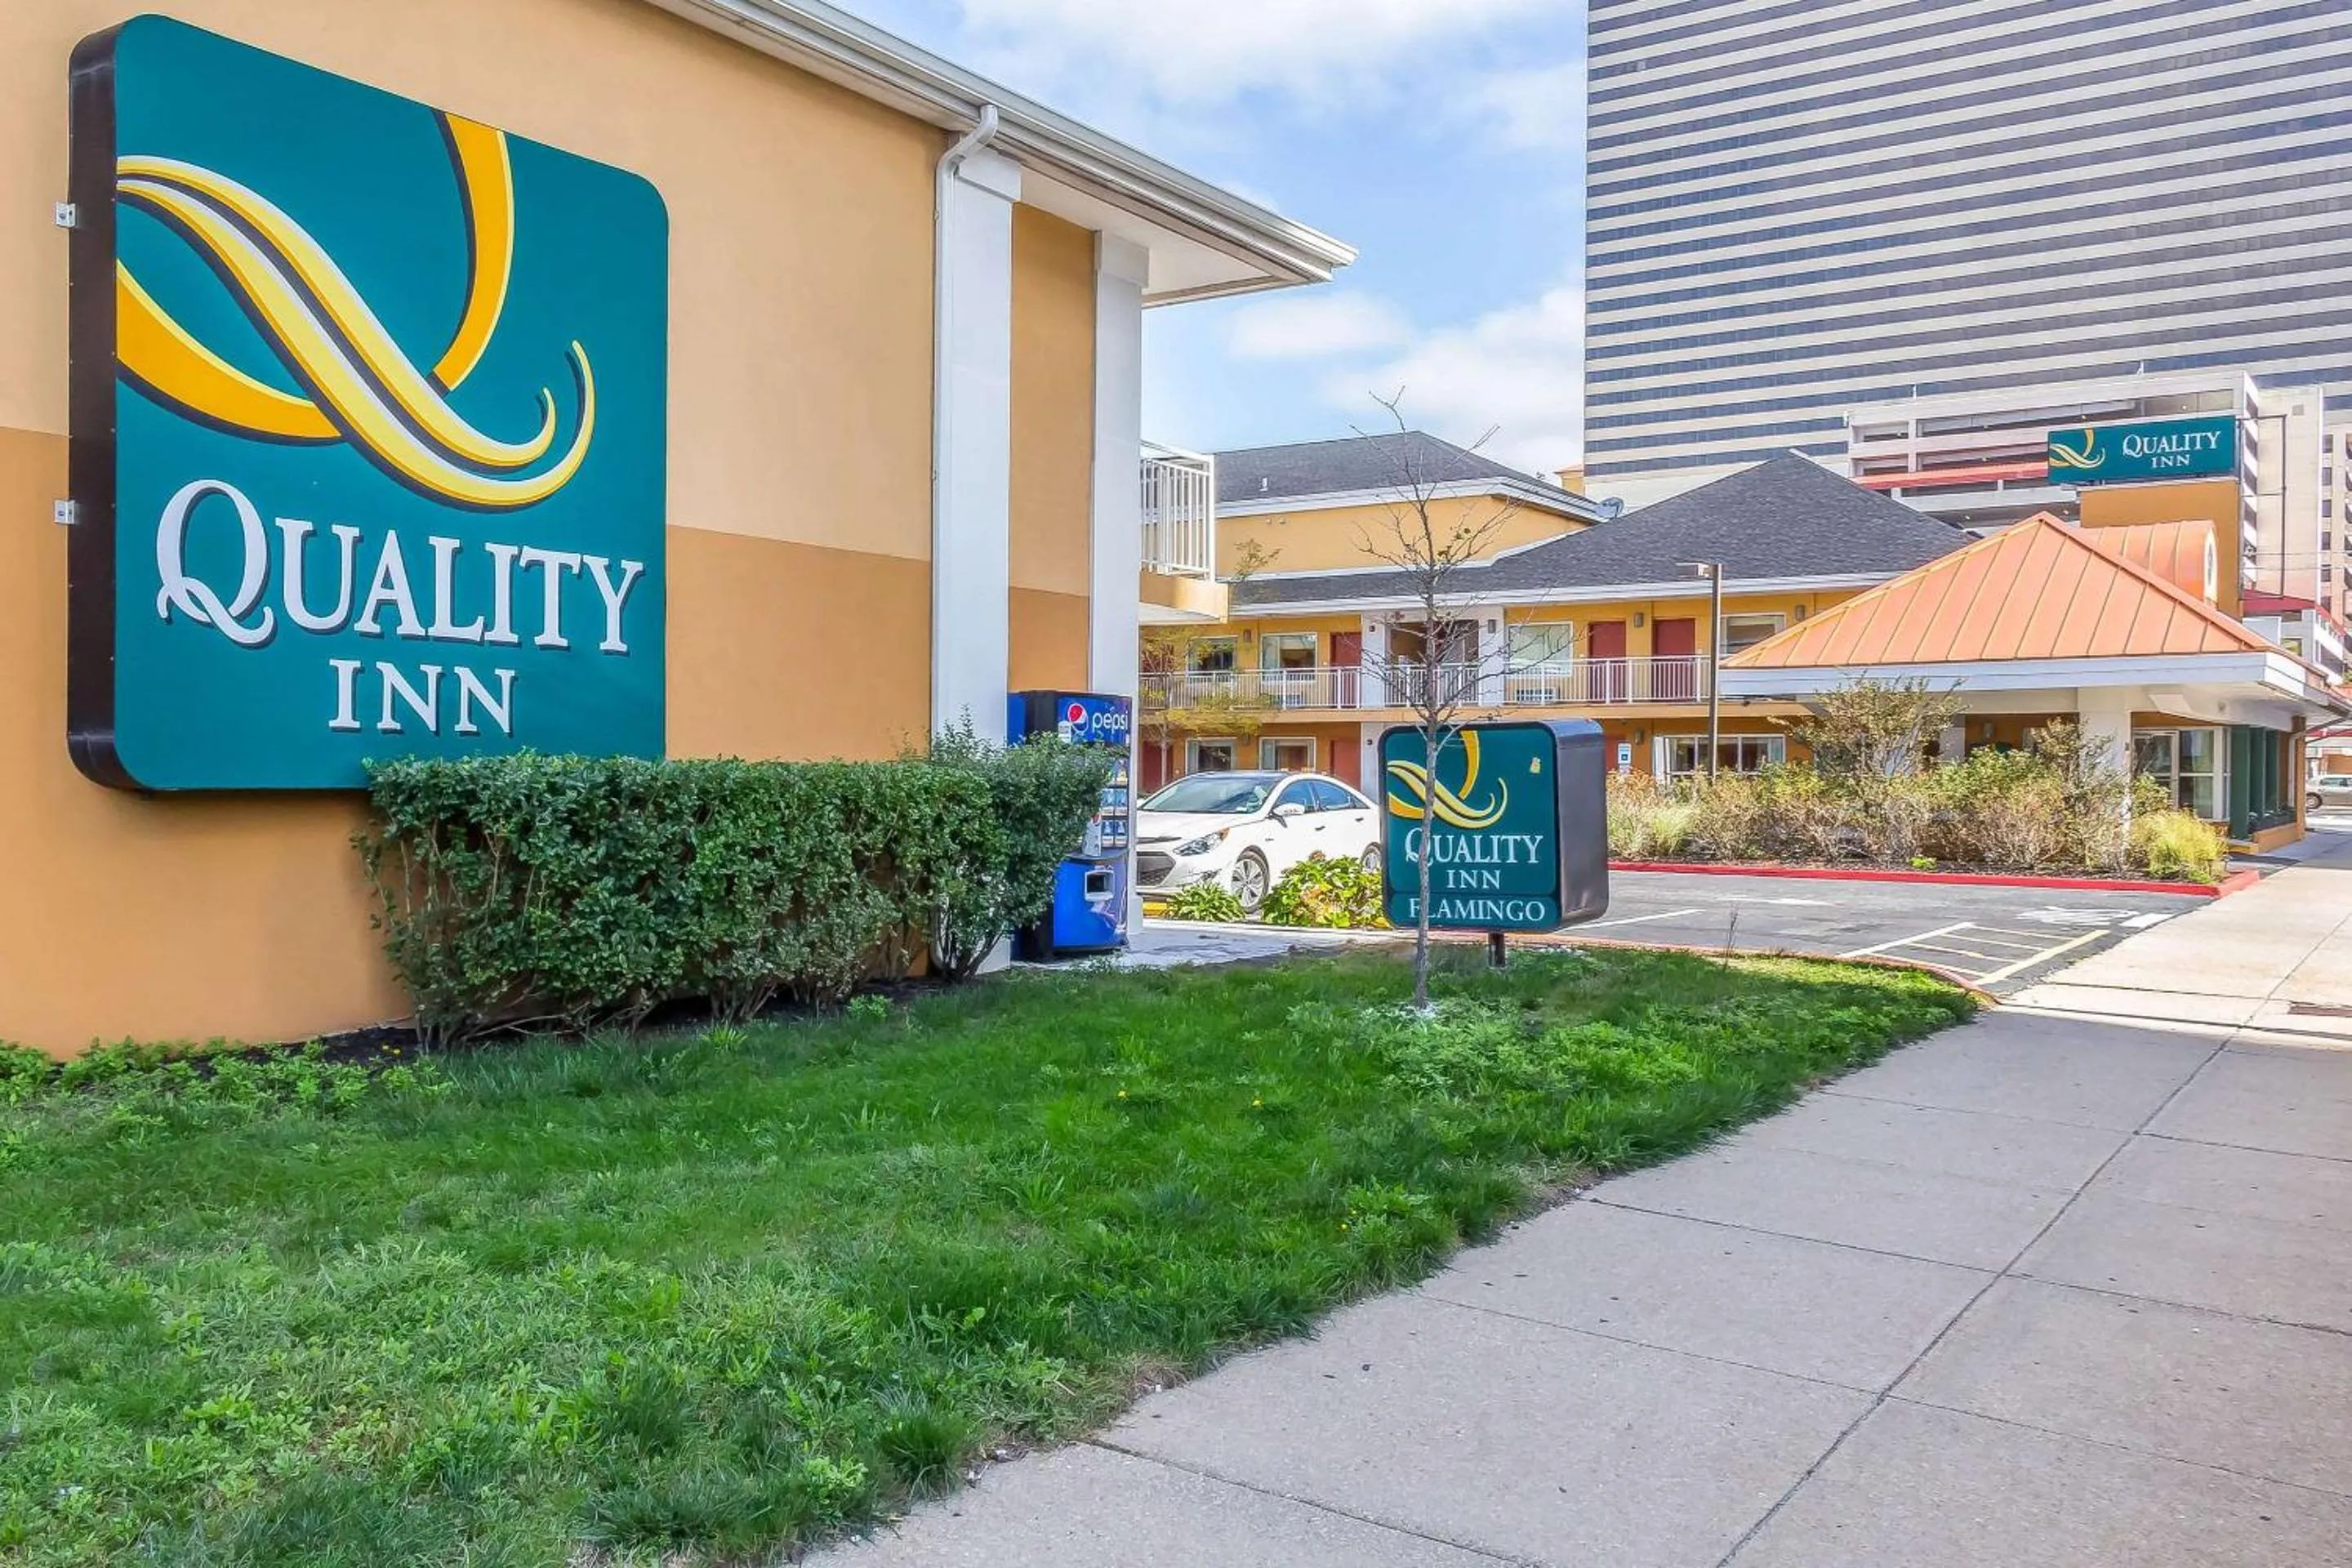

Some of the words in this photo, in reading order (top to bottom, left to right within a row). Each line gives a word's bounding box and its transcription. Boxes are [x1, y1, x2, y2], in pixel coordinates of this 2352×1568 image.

[2123, 430, 2221, 457] QUALITY
[2151, 454, 2190, 468] INN
[156, 478, 644, 654] QUALITY
[328, 658, 516, 734] INN
[1092, 710, 1129, 734] pepsi
[1405, 827, 1544, 867] QUALITY
[1447, 870, 1500, 889] INN
